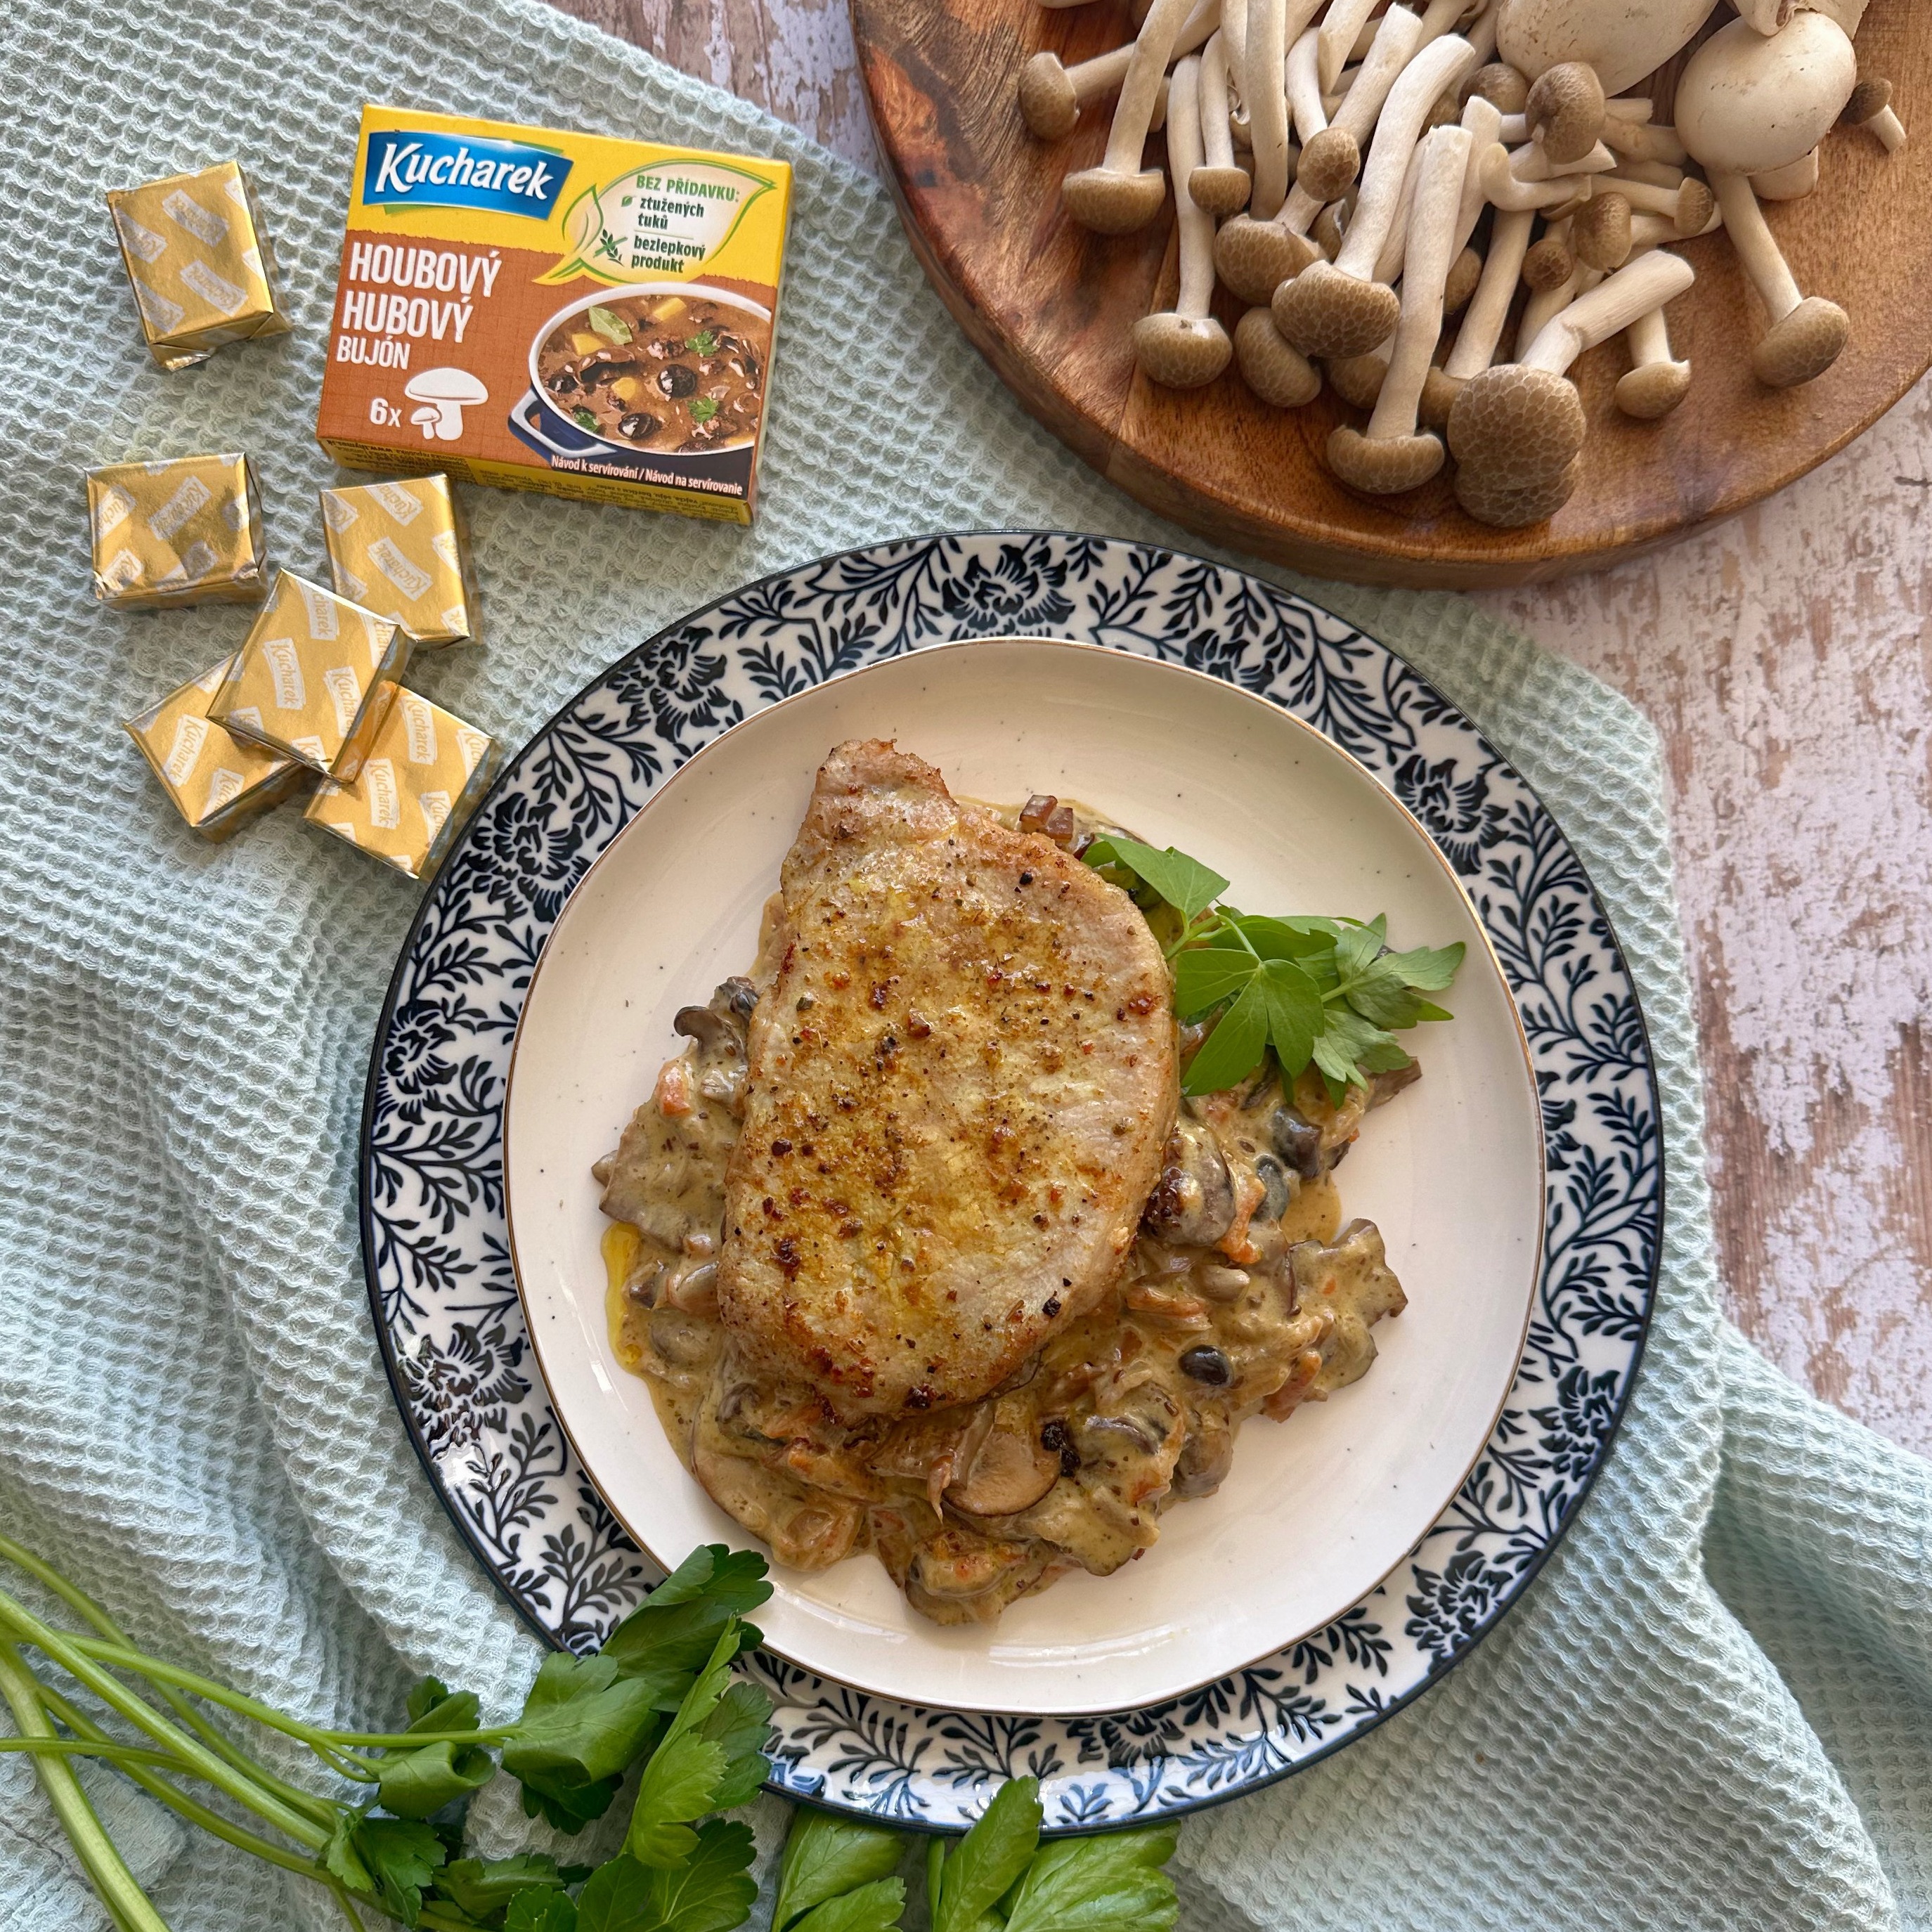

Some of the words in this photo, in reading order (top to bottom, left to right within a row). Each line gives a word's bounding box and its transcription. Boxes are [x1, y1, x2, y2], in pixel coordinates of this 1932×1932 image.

[375, 143, 554, 200] Kucharek
[636, 175, 661, 191] BEZ
[666, 177, 740, 202] PŘÍDAVKU:
[638, 213, 668, 230] tuků
[640, 197, 704, 218] ztužených
[349, 242, 502, 297] HOUBOVÝ
[631, 254, 685, 273] produkt
[634, 235, 706, 261] bezlepkový
[342, 290, 474, 343] HUBOVÝ
[336, 335, 410, 370] BUJÓN
[370, 398, 402, 427] 6x
[551, 454, 580, 471] Návod
[581, 460, 588, 472] k
[588, 462, 639, 480] servírování
[639, 468, 645, 481] /
[645, 469, 674, 485] Návod
[675, 476, 687, 486] na
[687, 477, 743, 495] servírovanie
[377, 485, 416, 519] Kucha
[374, 543, 426, 595] Kucharek
[312, 592, 330, 637] charek
[270, 644, 298, 705] Kucharek
[171, 720, 202, 779] Kucharek
[407, 700, 429, 760] Kucharek
[369, 766, 394, 823] Kucharek
